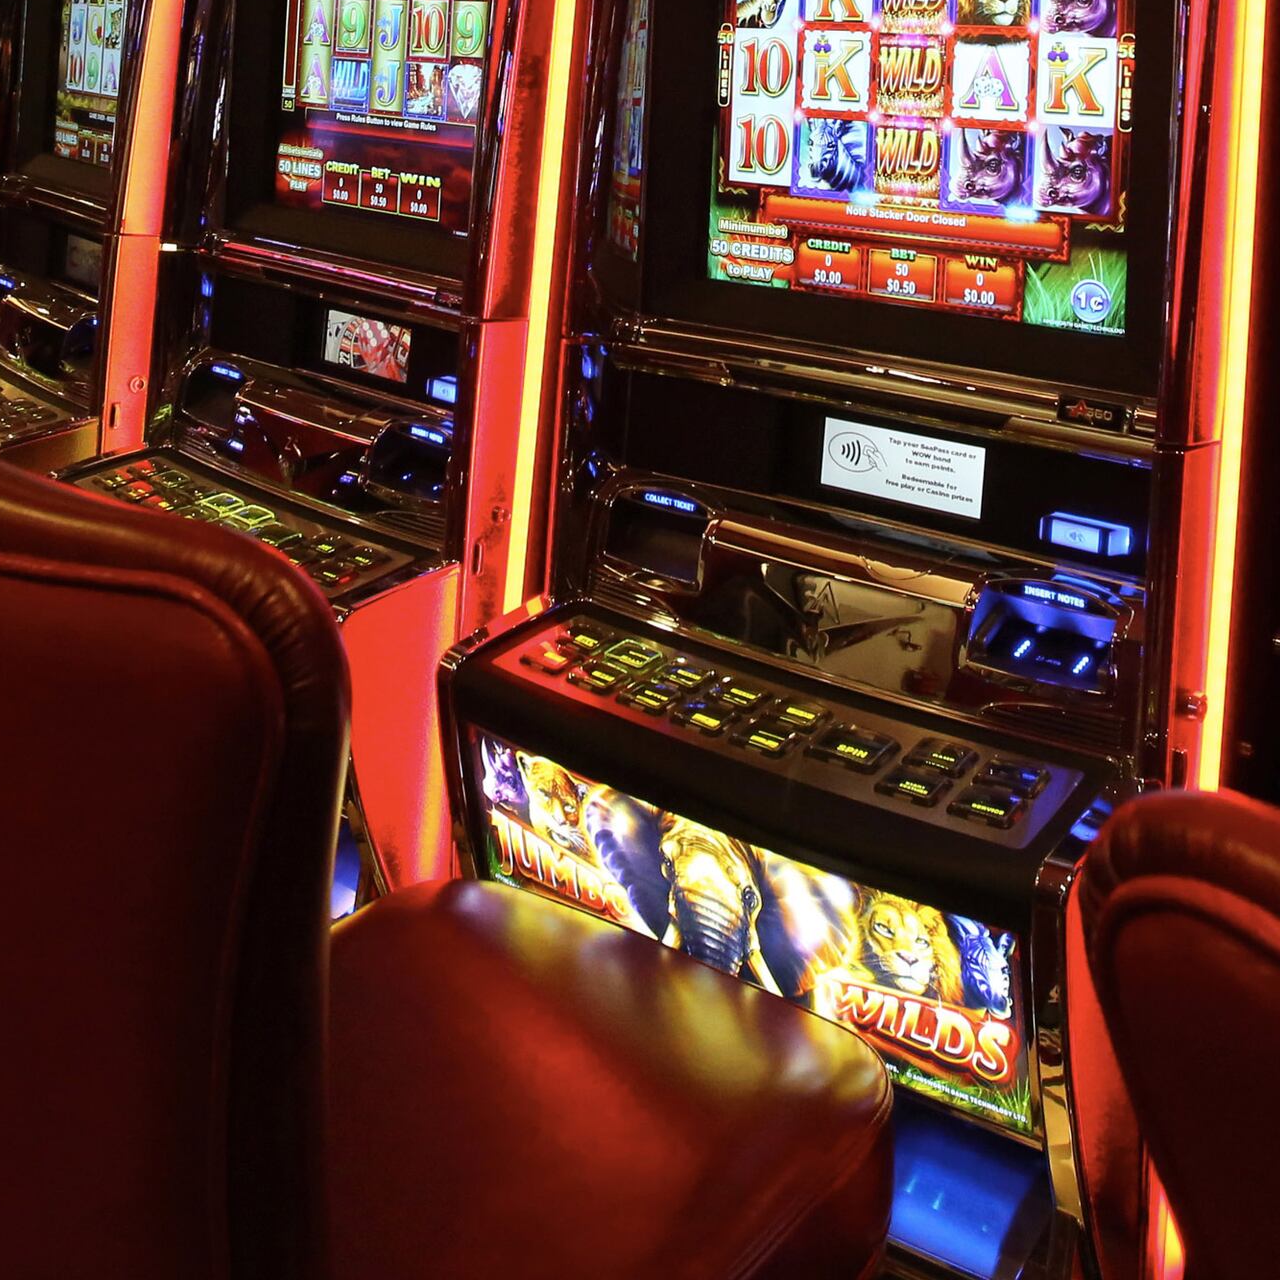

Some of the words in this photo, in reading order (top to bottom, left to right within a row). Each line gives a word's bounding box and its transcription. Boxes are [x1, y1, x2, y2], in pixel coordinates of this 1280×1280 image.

[412, 4, 445, 53] 10
[718, 32, 733, 45] 50
[739, 38, 794, 98] 10
[878, 45, 942, 94] WILD
[959, 44, 1020, 112] A
[737, 113, 789, 175] 10
[876, 126, 939, 175] WILD
[292, 162, 321, 177] LINES
[326, 161, 360, 175] CREDIT
[371, 167, 391, 180] BET
[400, 172, 441, 188] WIN
[846, 206, 867, 217] Note
[869, 208, 905, 221] Stacker
[907, 211, 929, 223] Door
[932, 215, 966, 227] Closed
[720, 219, 766, 235] Minimum
[768, 224, 786, 237] bet
[711, 240, 729, 254] 50
[731, 243, 794, 263] CREDITS
[807, 238, 851, 252] CREDIT
[825, 254, 832, 267] 0
[965, 254, 998, 271] WIN
[728, 264, 741, 276] to
[742, 266, 772, 281] PLAY
[814, 270, 842, 285] $0.00
[895, 263, 909, 276] 50
[887, 278, 916, 294] $0.50
[976, 273, 984, 286] 0
[964, 290, 995, 305] $0.00
[888, 437, 902, 446] Tap
[903, 440, 919, 449] your
[920, 443, 949, 455] SeaPass
[951, 449, 967, 459] card
[911, 450, 931, 460] WOW
[905, 457, 913, 465] to
[914, 460, 930, 469] earn
[901, 473, 945, 489] Redeemable
[946, 482, 957, 491] for
[885, 478, 899, 487] free
[900, 482, 916, 492] play
[926, 487, 950, 499] Casino
[951, 493, 973, 504] prizes
[644, 492, 672, 507] COLLECT
[673, 499, 695, 513] TICKET
[1024, 584, 1056, 601] INSERT
[1057, 592, 1085, 609] NOTES
[836, 742, 868, 759] SPIN
[491, 807, 632, 922] JUMBO
[832, 980, 1014, 1083] WILDS
